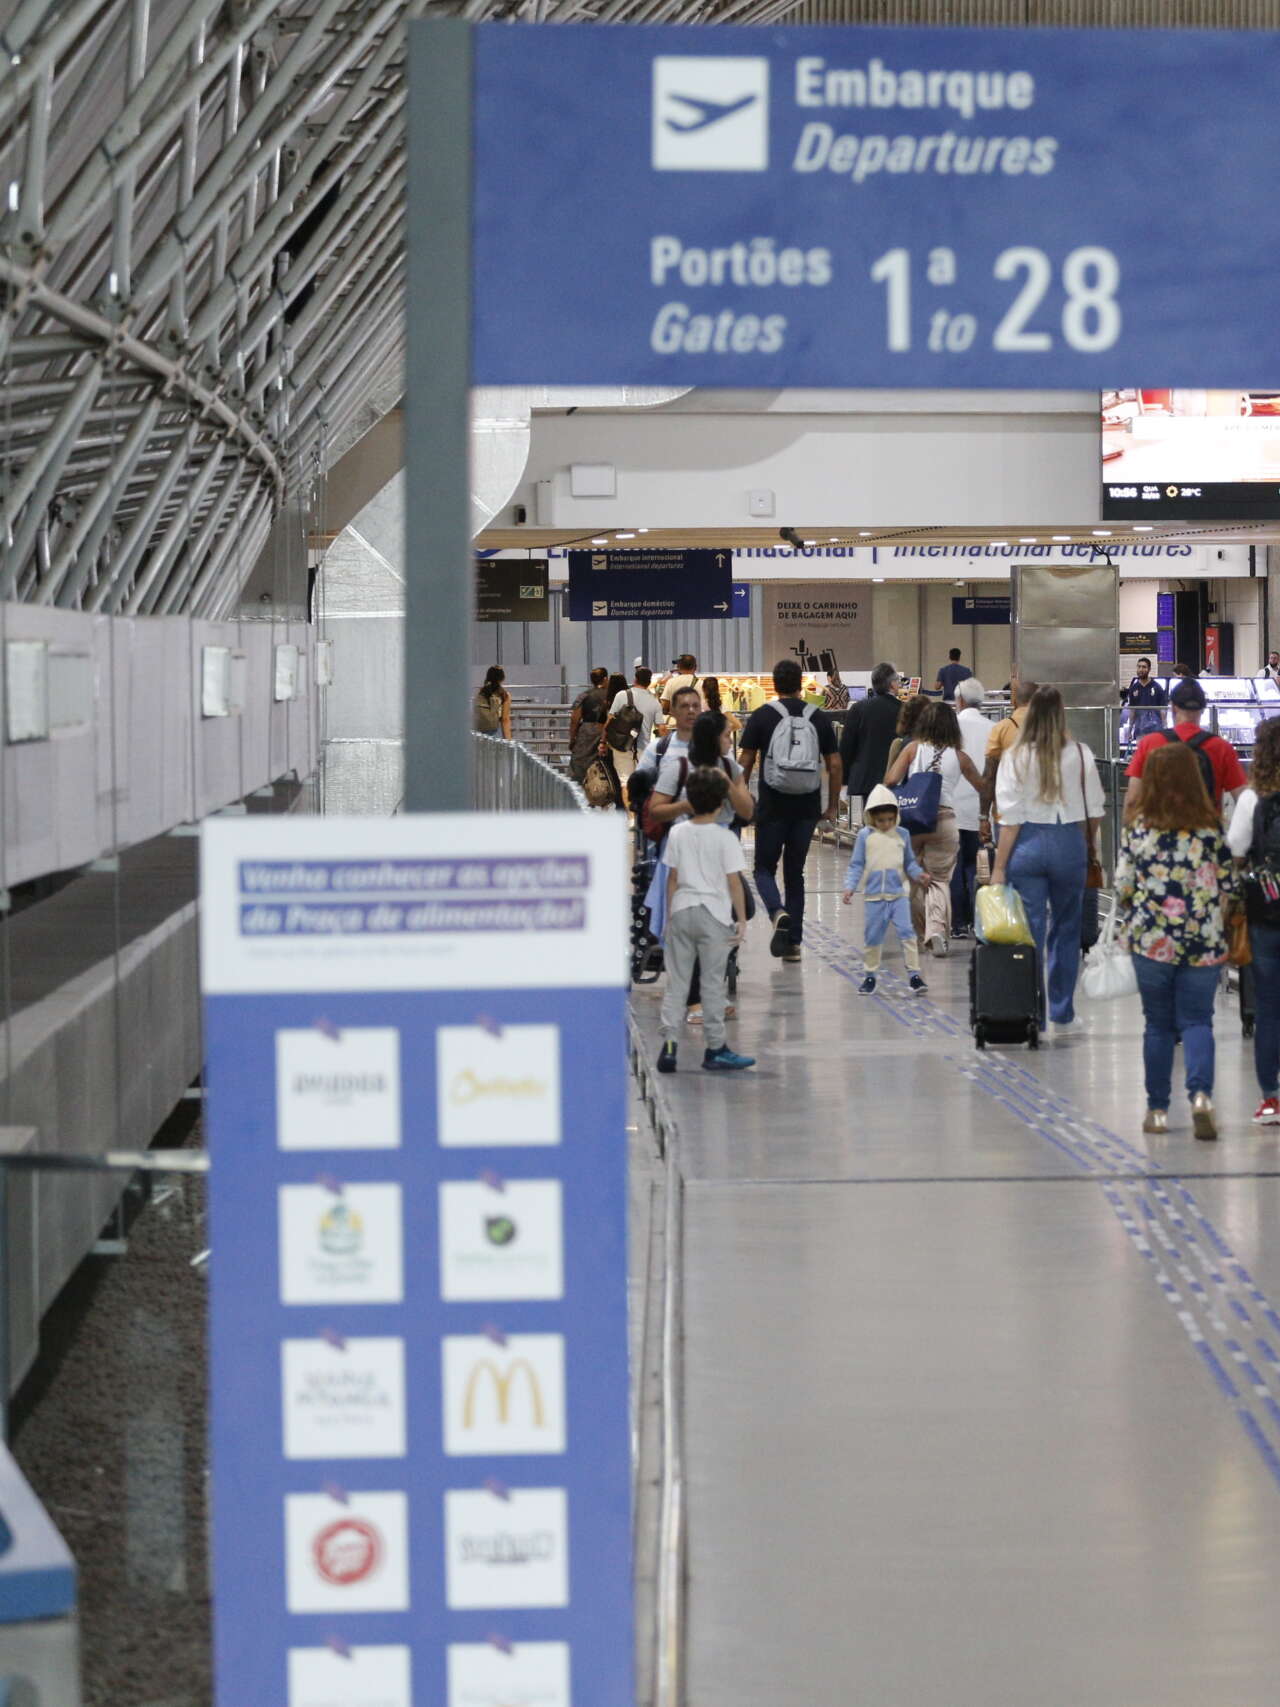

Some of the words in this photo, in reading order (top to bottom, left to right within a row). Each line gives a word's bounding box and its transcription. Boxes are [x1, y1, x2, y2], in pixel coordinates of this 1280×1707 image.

[795, 58, 1035, 118] Embarque
[793, 123, 1058, 183] Departures
[650, 236, 832, 288] Portões
[870, 247, 912, 353] 1
[927, 248, 955, 286] a
[992, 246, 1123, 354] 28
[650, 303, 786, 356] Gates
[927, 307, 976, 354] to
[777, 602, 802, 610] DEIXE
[813, 602, 858, 610] CARRINHO
[836, 612, 857, 620] AQUI
